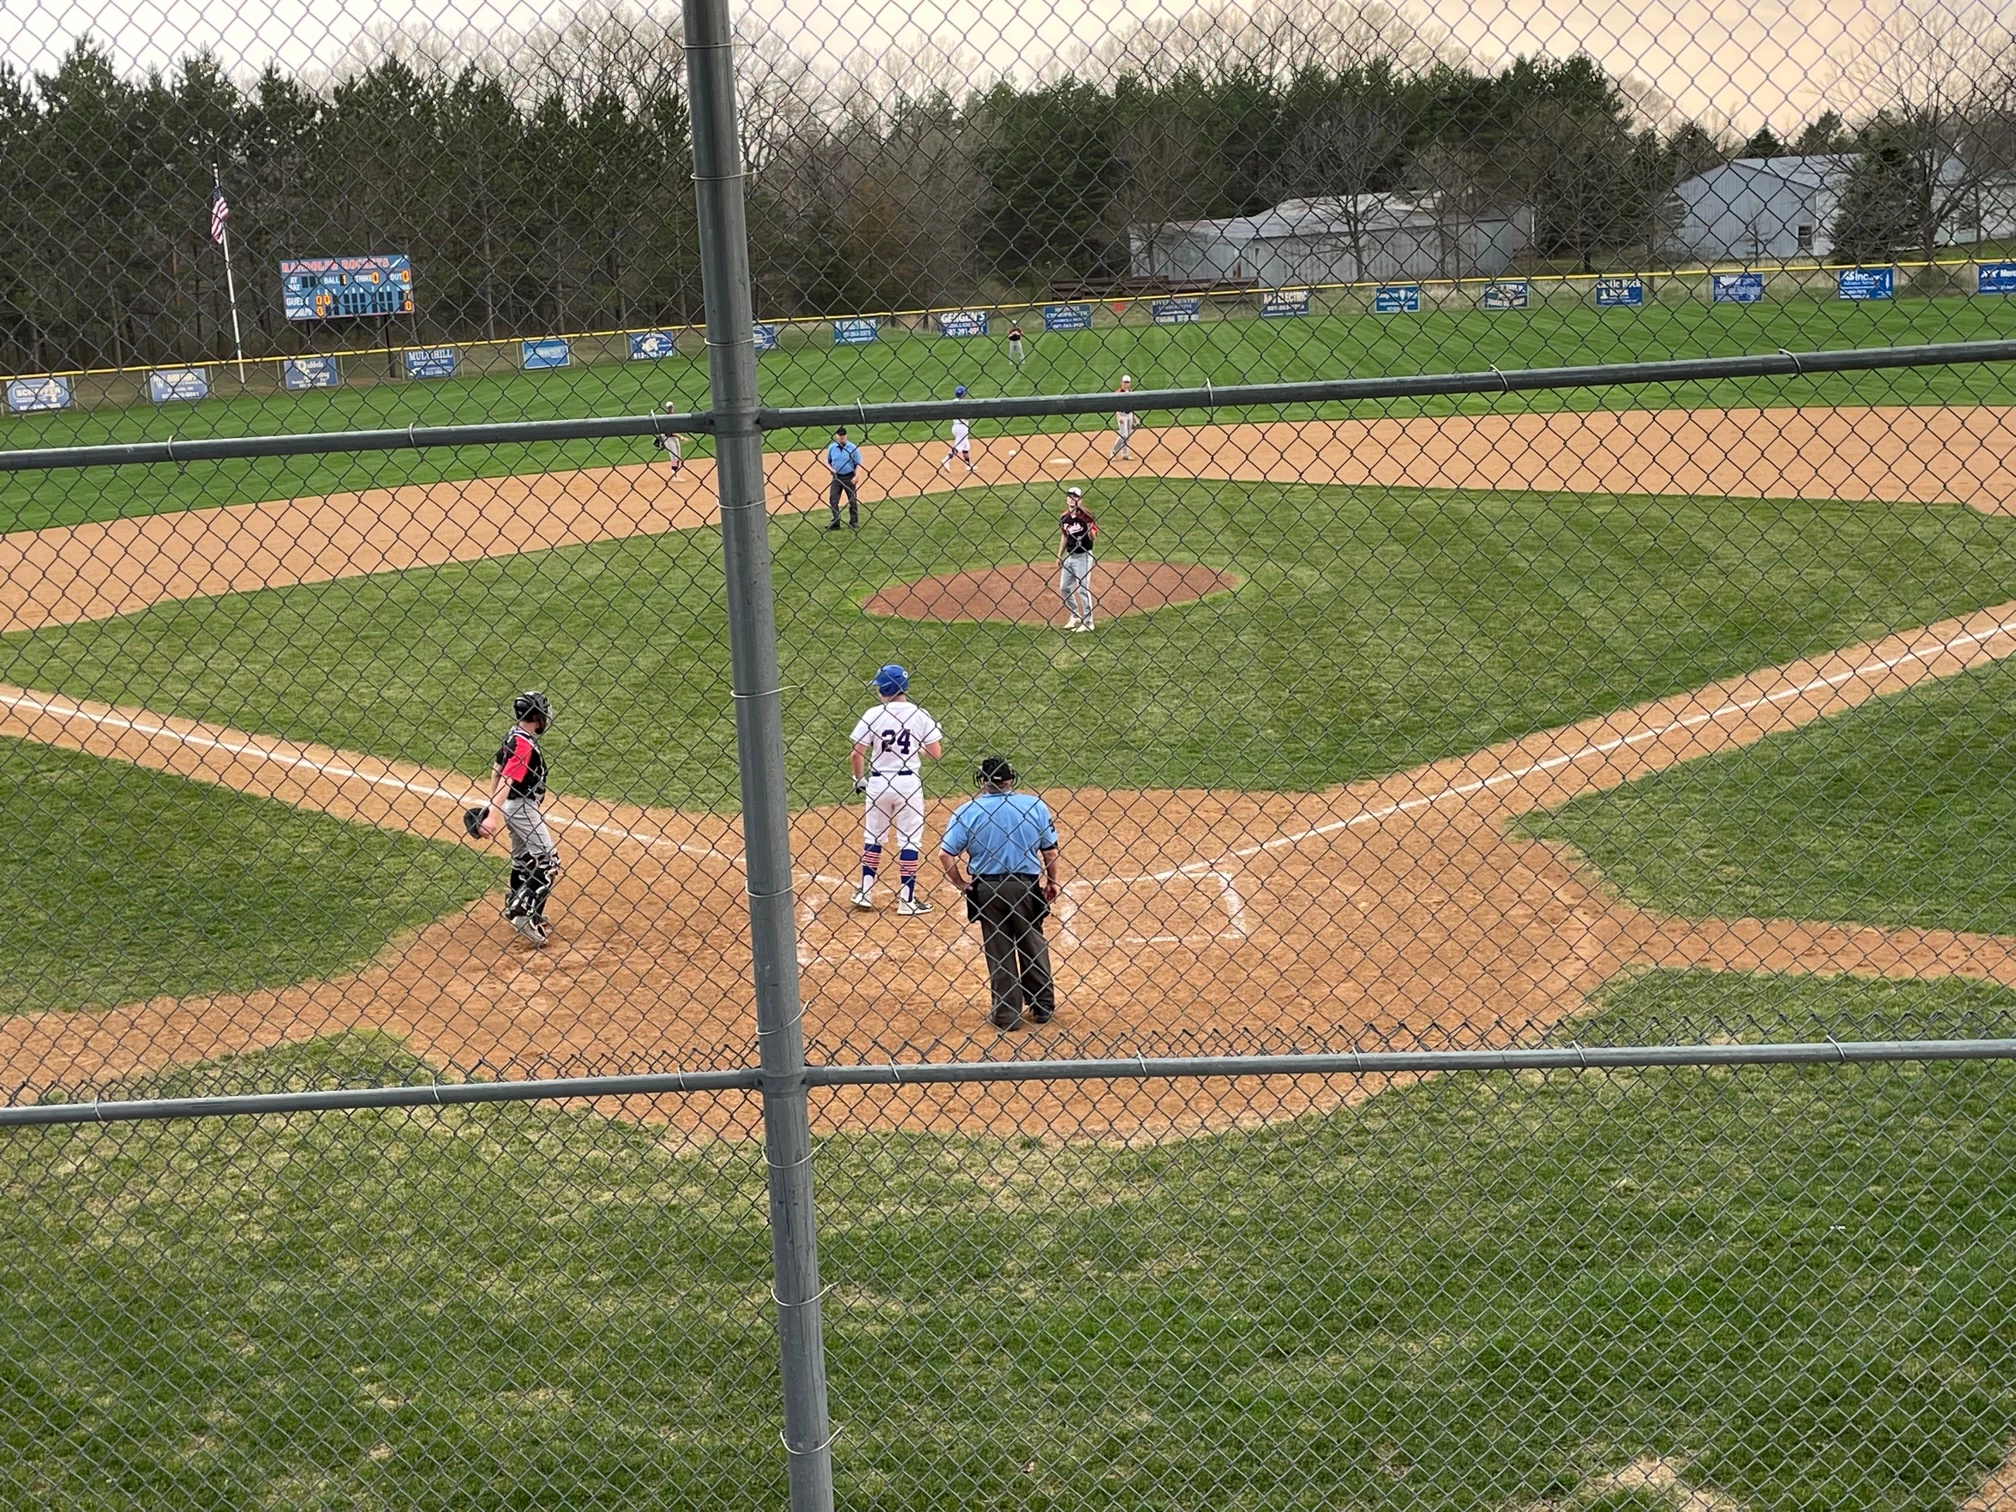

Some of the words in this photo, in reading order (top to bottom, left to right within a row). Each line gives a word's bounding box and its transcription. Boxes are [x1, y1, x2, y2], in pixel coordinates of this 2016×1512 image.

[282, 260, 339, 273] RANDOLPH
[341, 257, 389, 270] ROCKETS
[324, 276, 340, 285] BALL
[1622, 278, 1642, 288] Rock
[1277, 290, 1309, 304] ELECTRIC
[881, 728, 911, 755] 24
